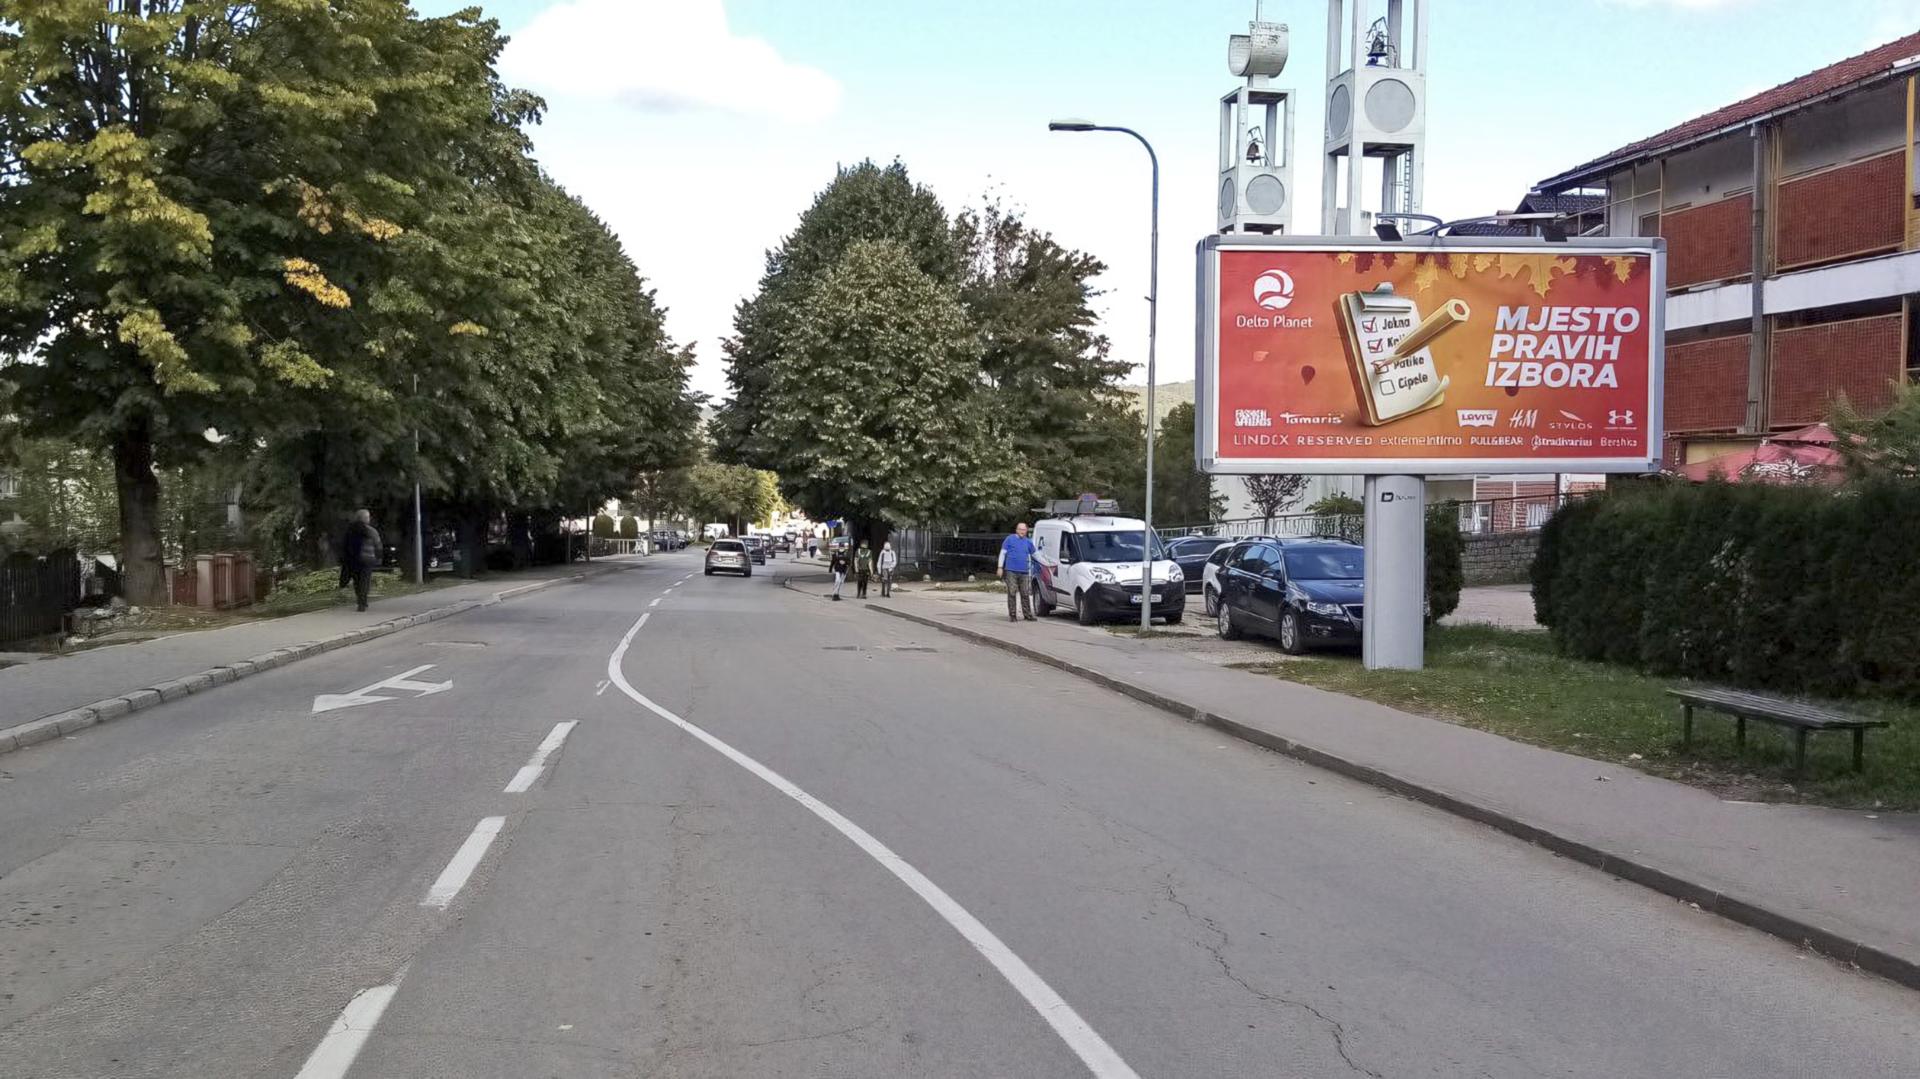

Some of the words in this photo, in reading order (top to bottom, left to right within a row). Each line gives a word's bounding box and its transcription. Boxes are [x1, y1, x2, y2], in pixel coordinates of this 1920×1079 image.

[1236, 315, 1269, 328] Delta
[1273, 315, 1313, 328] Planet
[1494, 305, 1640, 333] MJESTO
[1489, 334, 1622, 360] PRAVIH
[1398, 373, 1428, 390] Cipele
[1484, 362, 1619, 389] IZBORA
[1280, 412, 1342, 424] Tamaris
[1234, 434, 1289, 446] LINDEX
[1297, 436, 1373, 446] RESERVED
[1470, 436, 1525, 446] PULL&BEAR
[1600, 436, 1637, 447] Bershka
